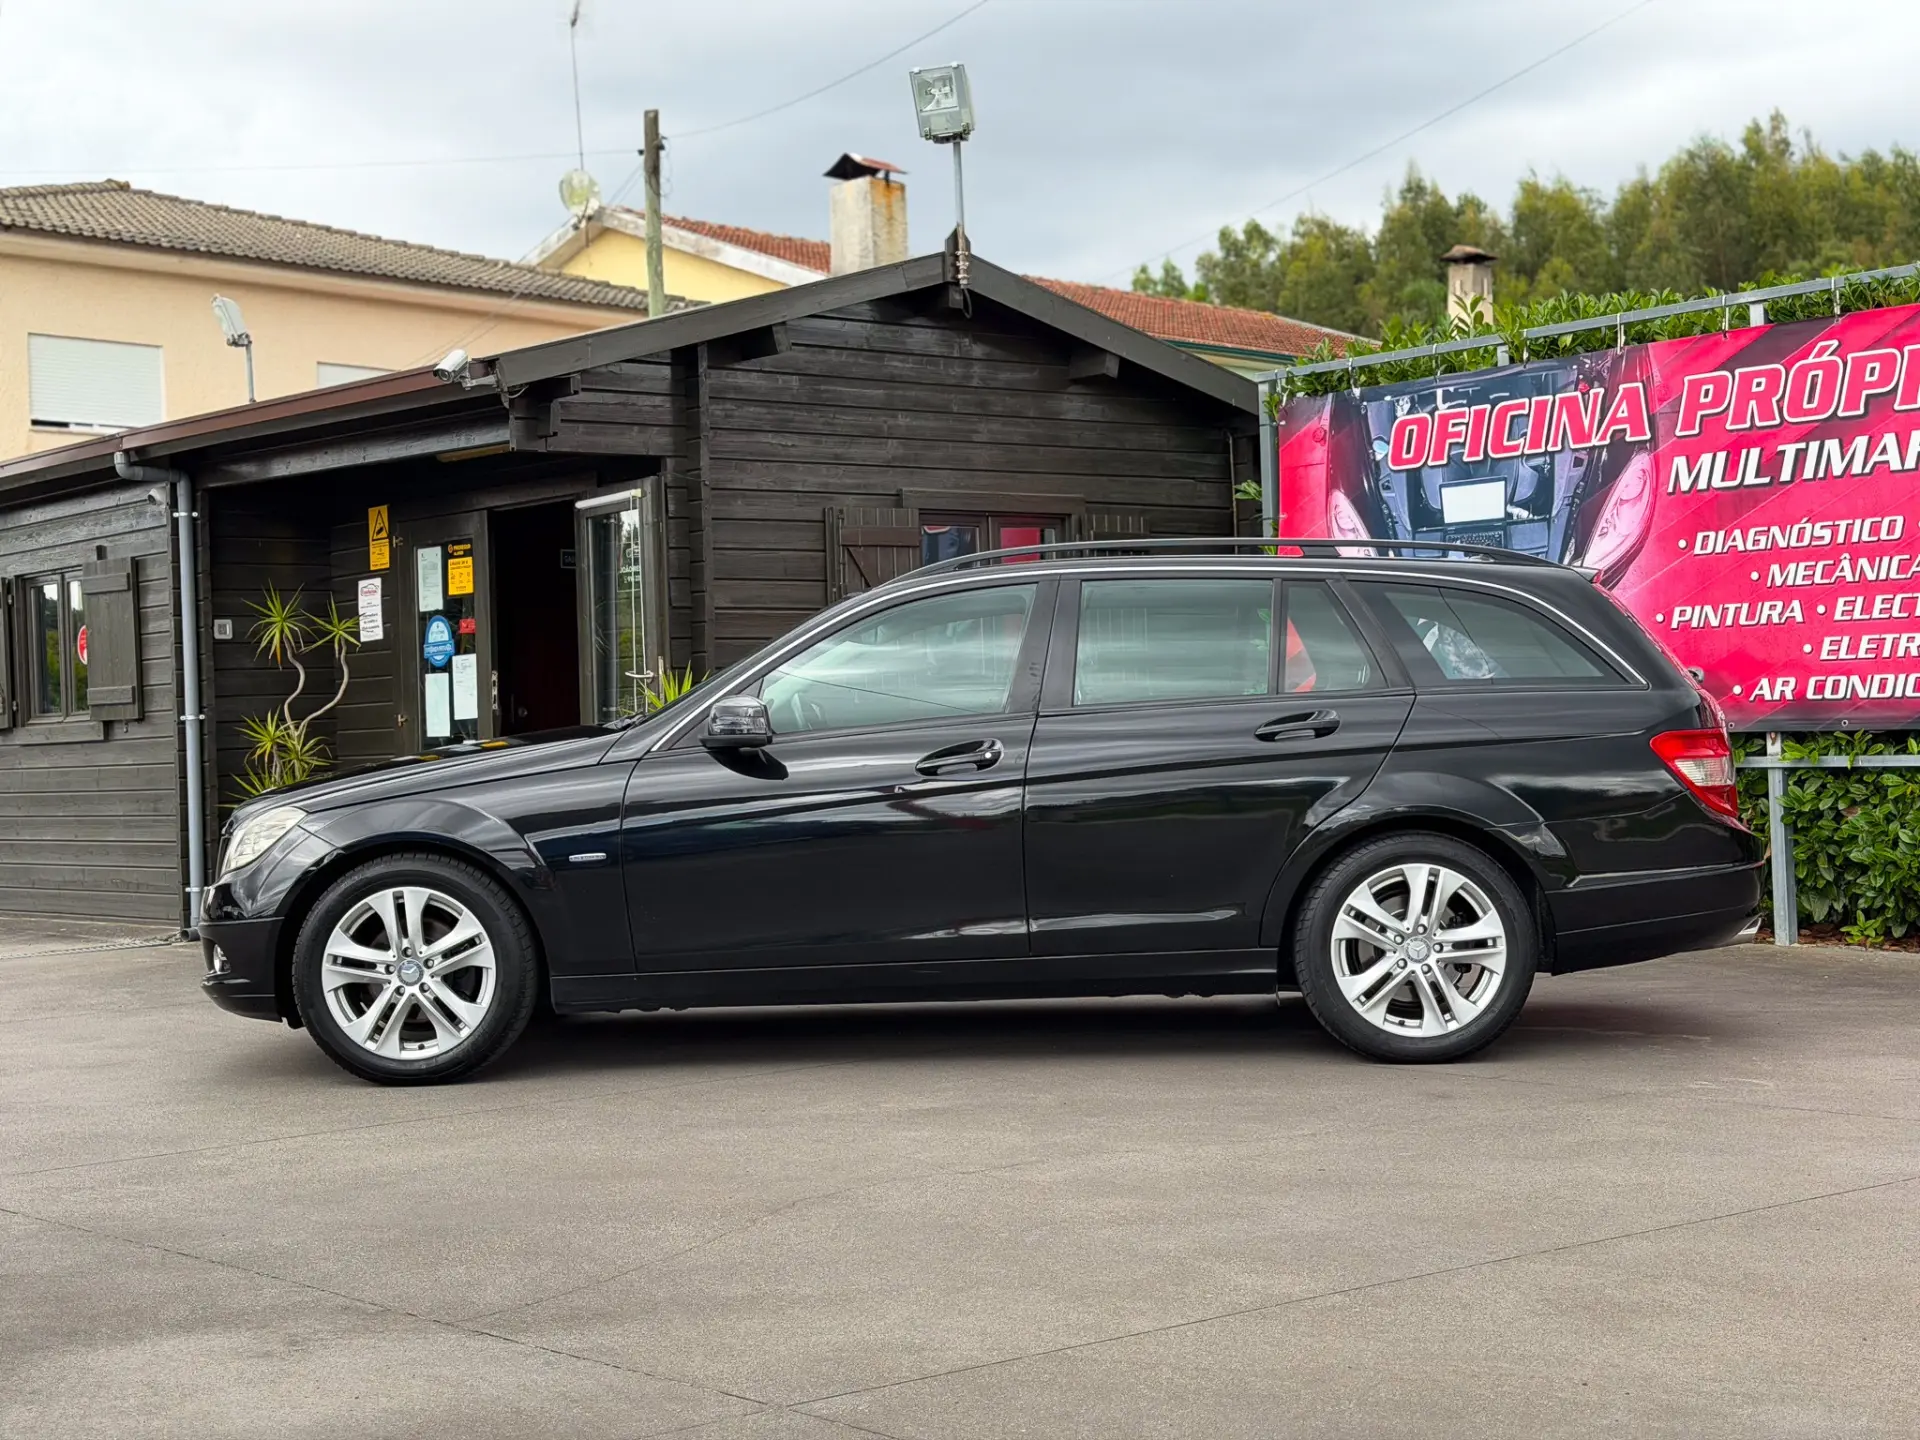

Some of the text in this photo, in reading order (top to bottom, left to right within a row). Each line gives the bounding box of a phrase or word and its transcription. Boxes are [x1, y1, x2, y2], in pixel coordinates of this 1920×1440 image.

[1388, 382, 1651, 470] OFICINA
[1694, 515, 1904, 555] DIAGNÓSTICO
[1670, 600, 1803, 629] PINTURA
[1749, 677, 1796, 701] AR
